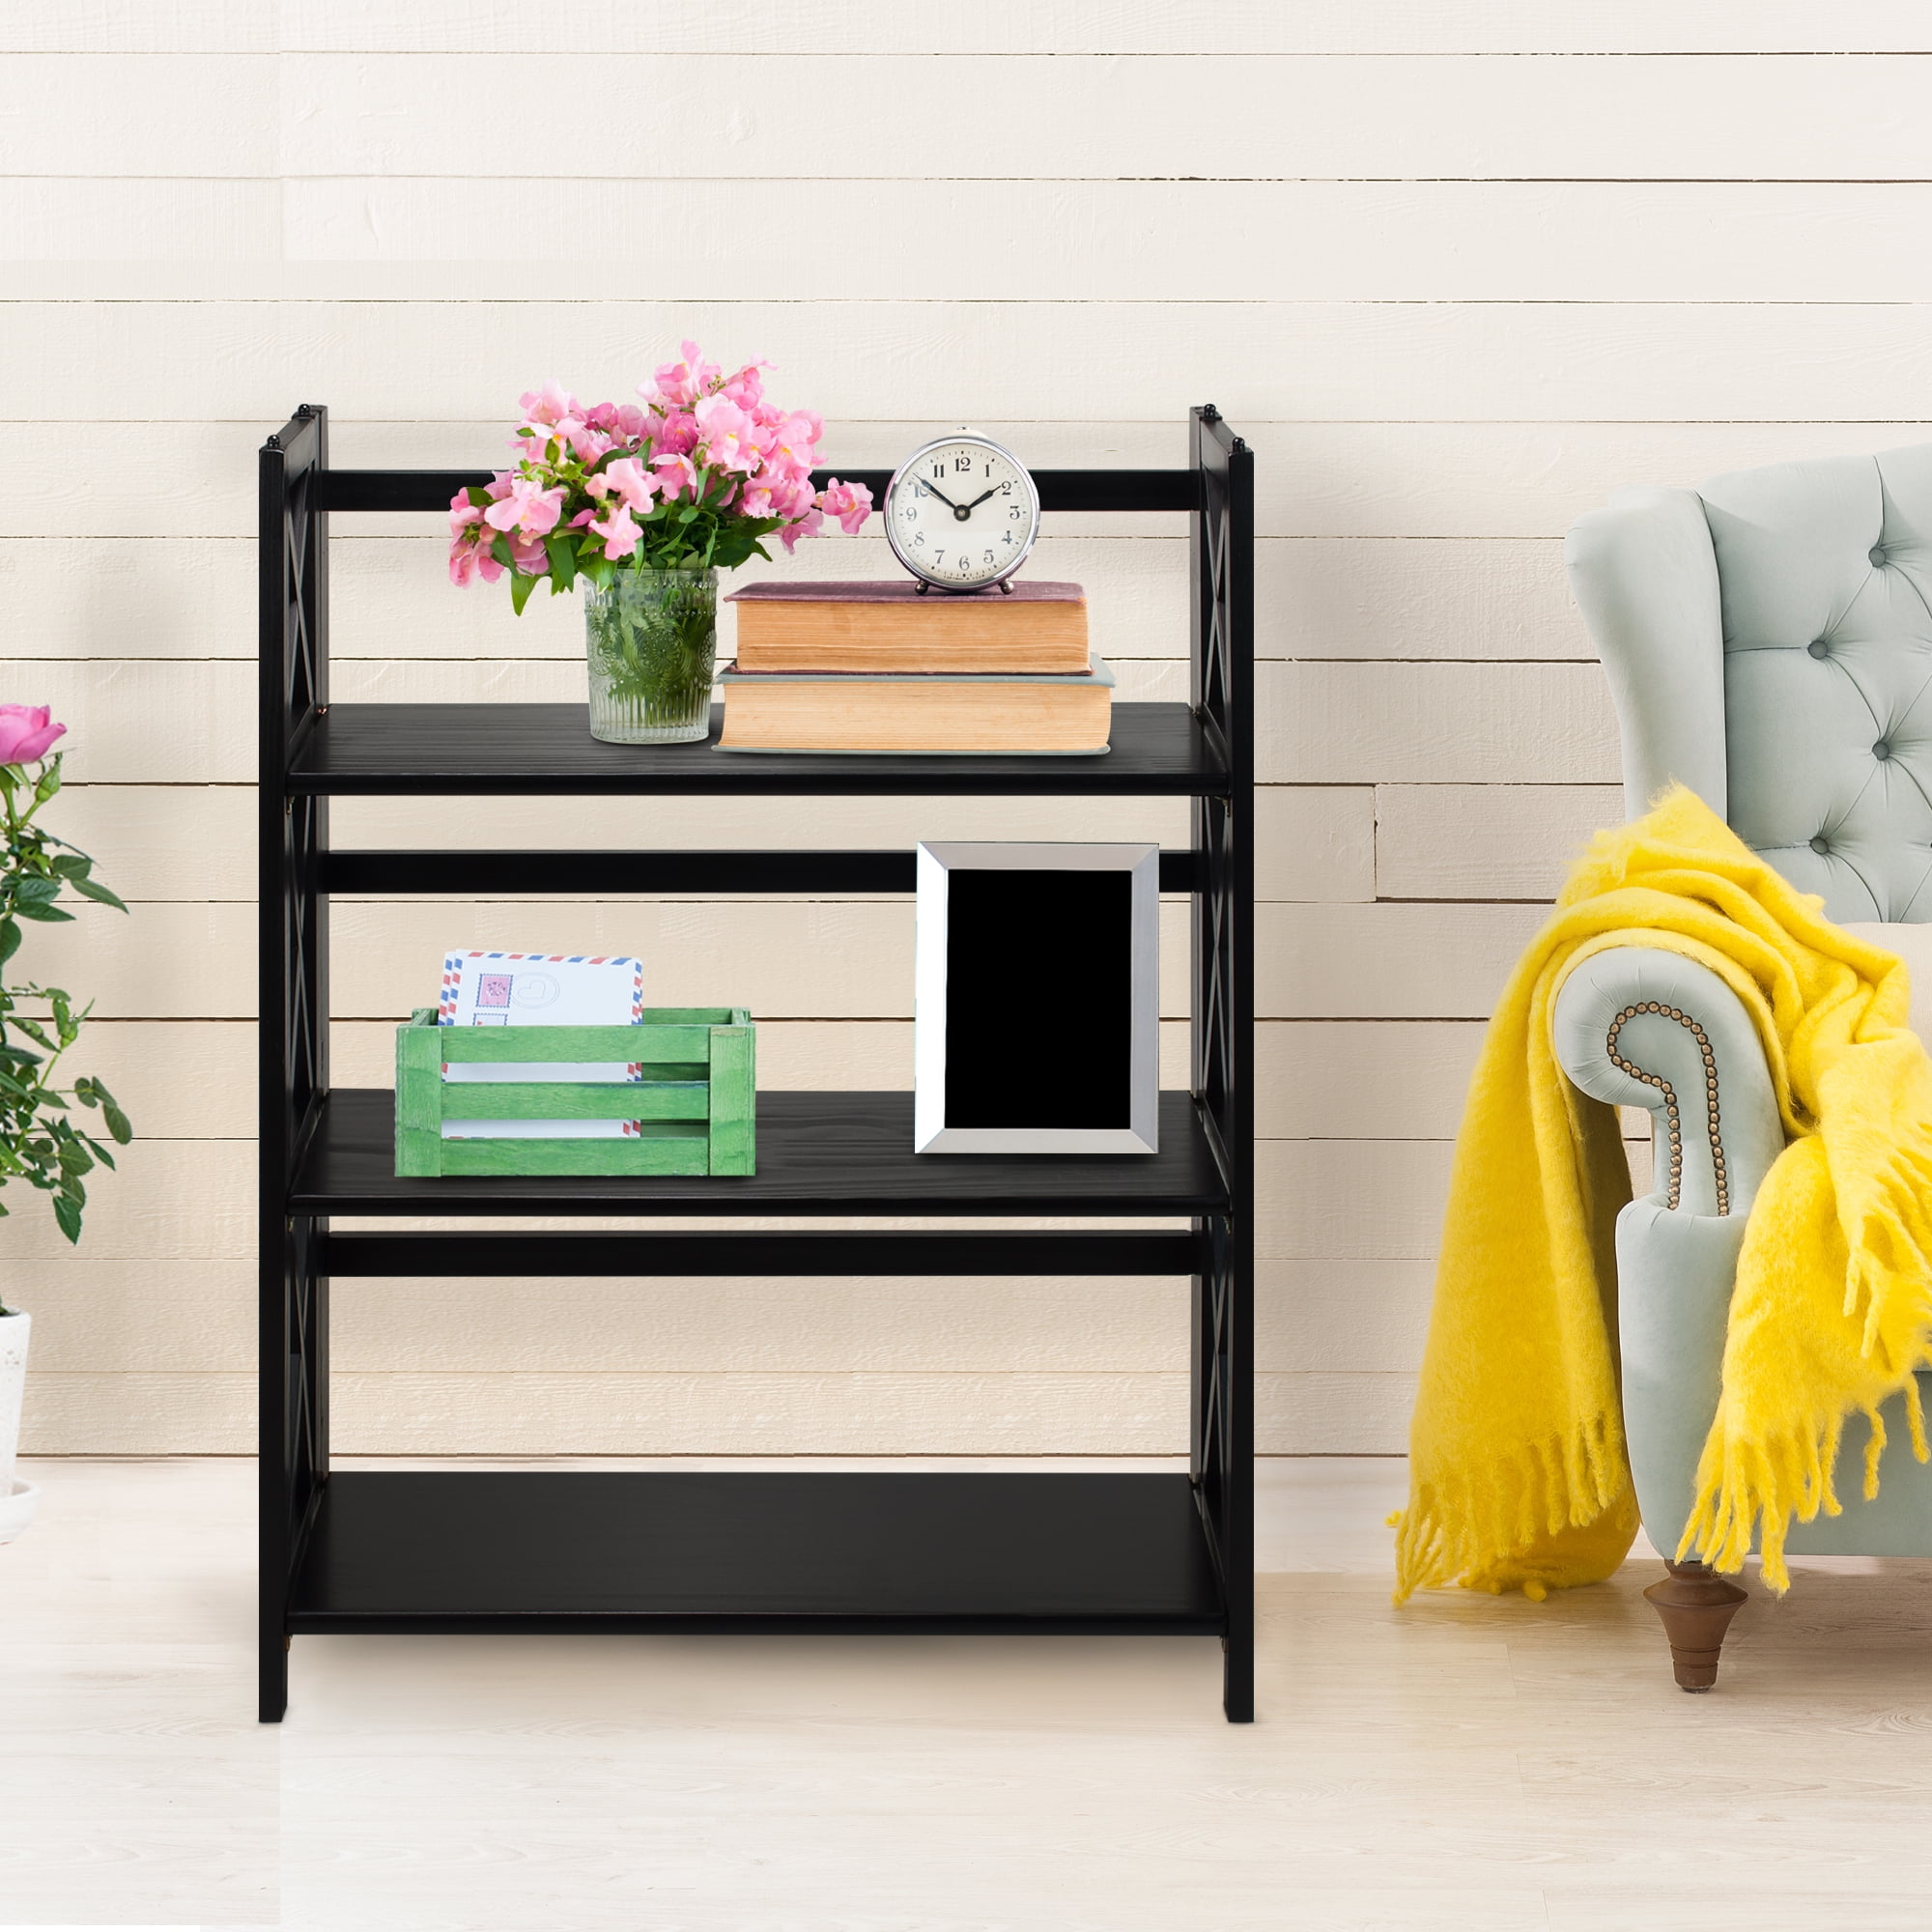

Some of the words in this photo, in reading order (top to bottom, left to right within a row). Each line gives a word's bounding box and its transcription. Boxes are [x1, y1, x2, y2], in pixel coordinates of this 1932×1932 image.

[955, 457, 971, 471] 12
[985, 464, 990, 477] 1
[934, 465, 945, 478] 11
[1001, 481, 1011, 496] 2
[906, 507, 917, 522] 9
[1009, 505, 1020, 520] 3
[914, 531, 924, 546] 8
[1001, 530, 1012, 544] 4
[935, 550, 945, 564] 7
[959, 555, 970, 571] 6
[983, 550, 994, 563] 5
